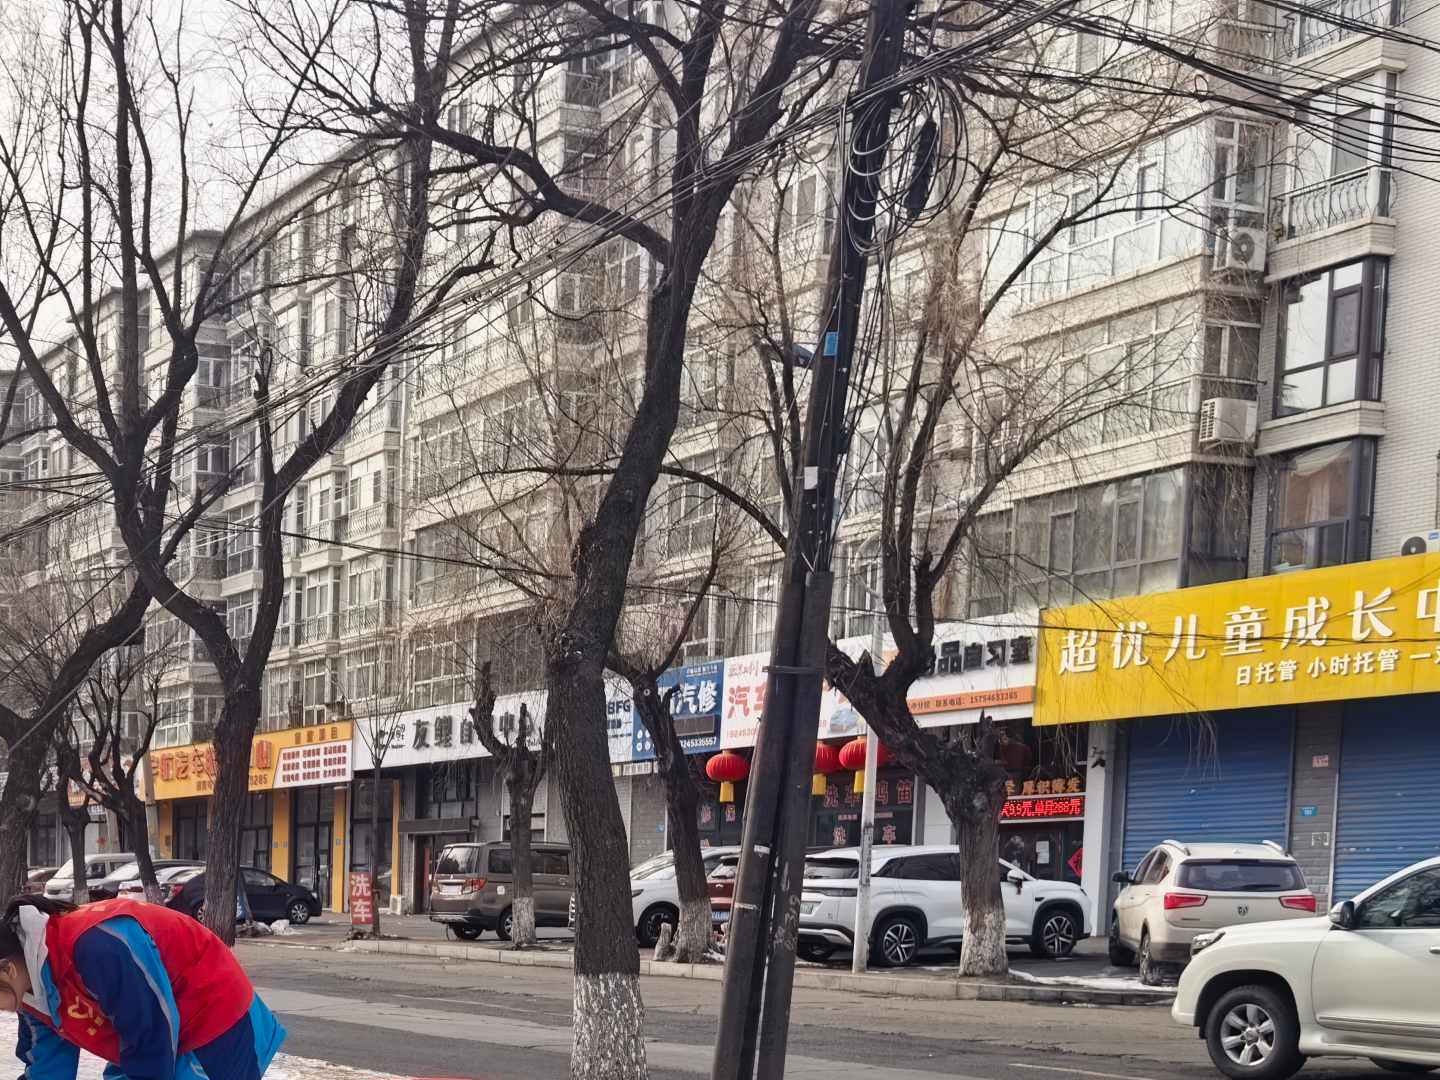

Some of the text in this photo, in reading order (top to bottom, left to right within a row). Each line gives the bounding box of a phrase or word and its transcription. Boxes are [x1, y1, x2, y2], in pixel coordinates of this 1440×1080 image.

[1236, 645, 1440, 686] 日托管 小时托管 一
[658, 679, 718, 715] 汽修
[351, 873, 372, 922] 洗车
